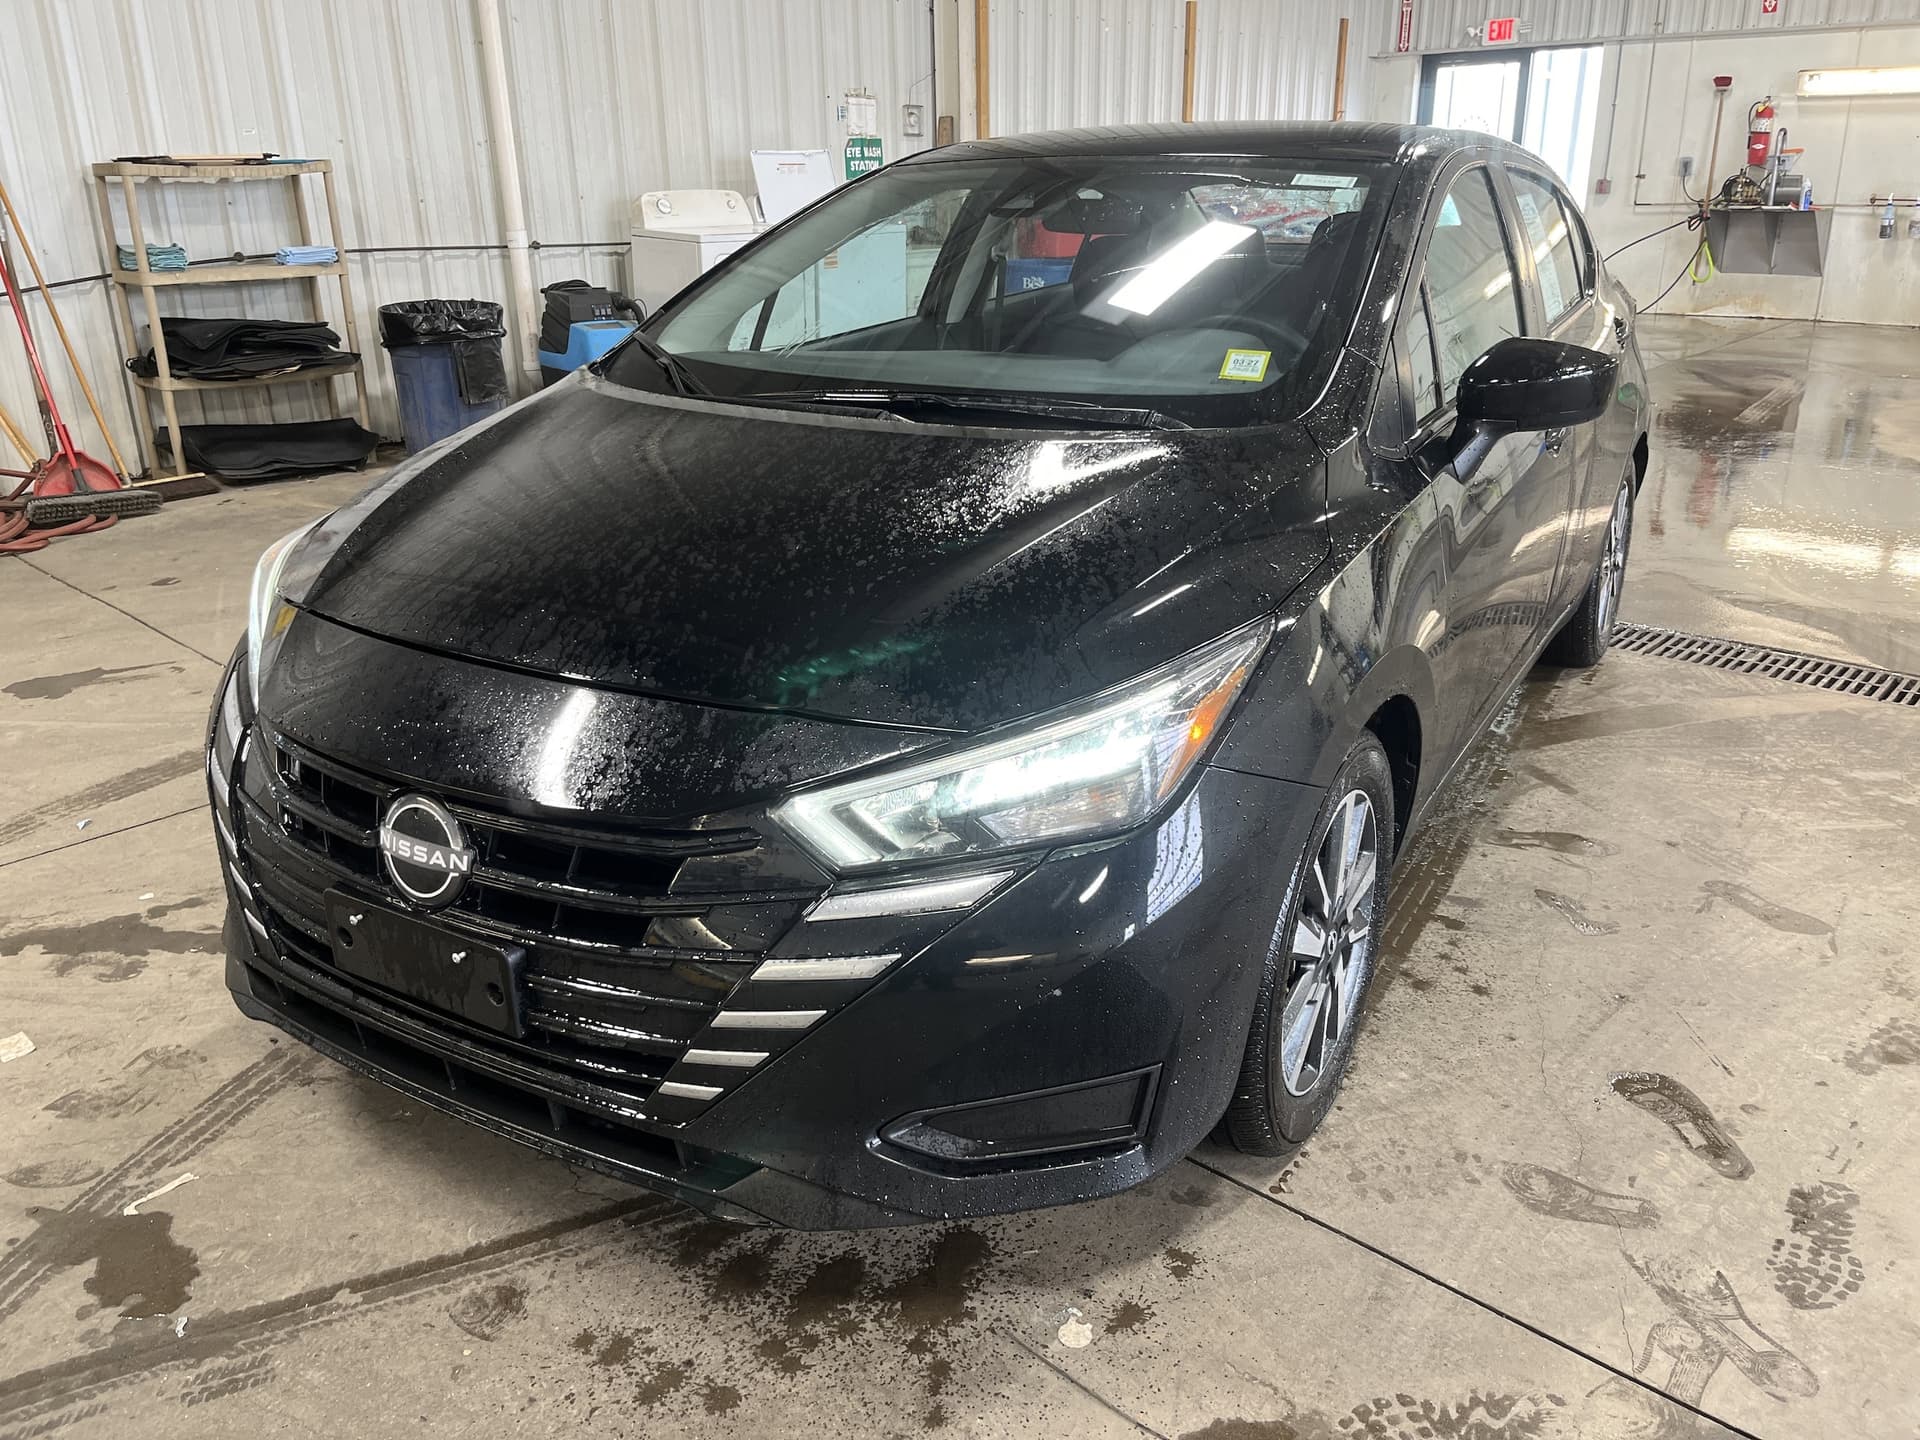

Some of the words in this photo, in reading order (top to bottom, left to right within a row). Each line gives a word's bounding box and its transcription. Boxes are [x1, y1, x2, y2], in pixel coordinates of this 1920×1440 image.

[1488, 19, 1513, 41] EXIT
[846, 147, 862, 158] EYE
[863, 147, 881, 158] WASH
[850, 160, 880, 172] STATION
[380, 829, 468, 871] NISSAN
